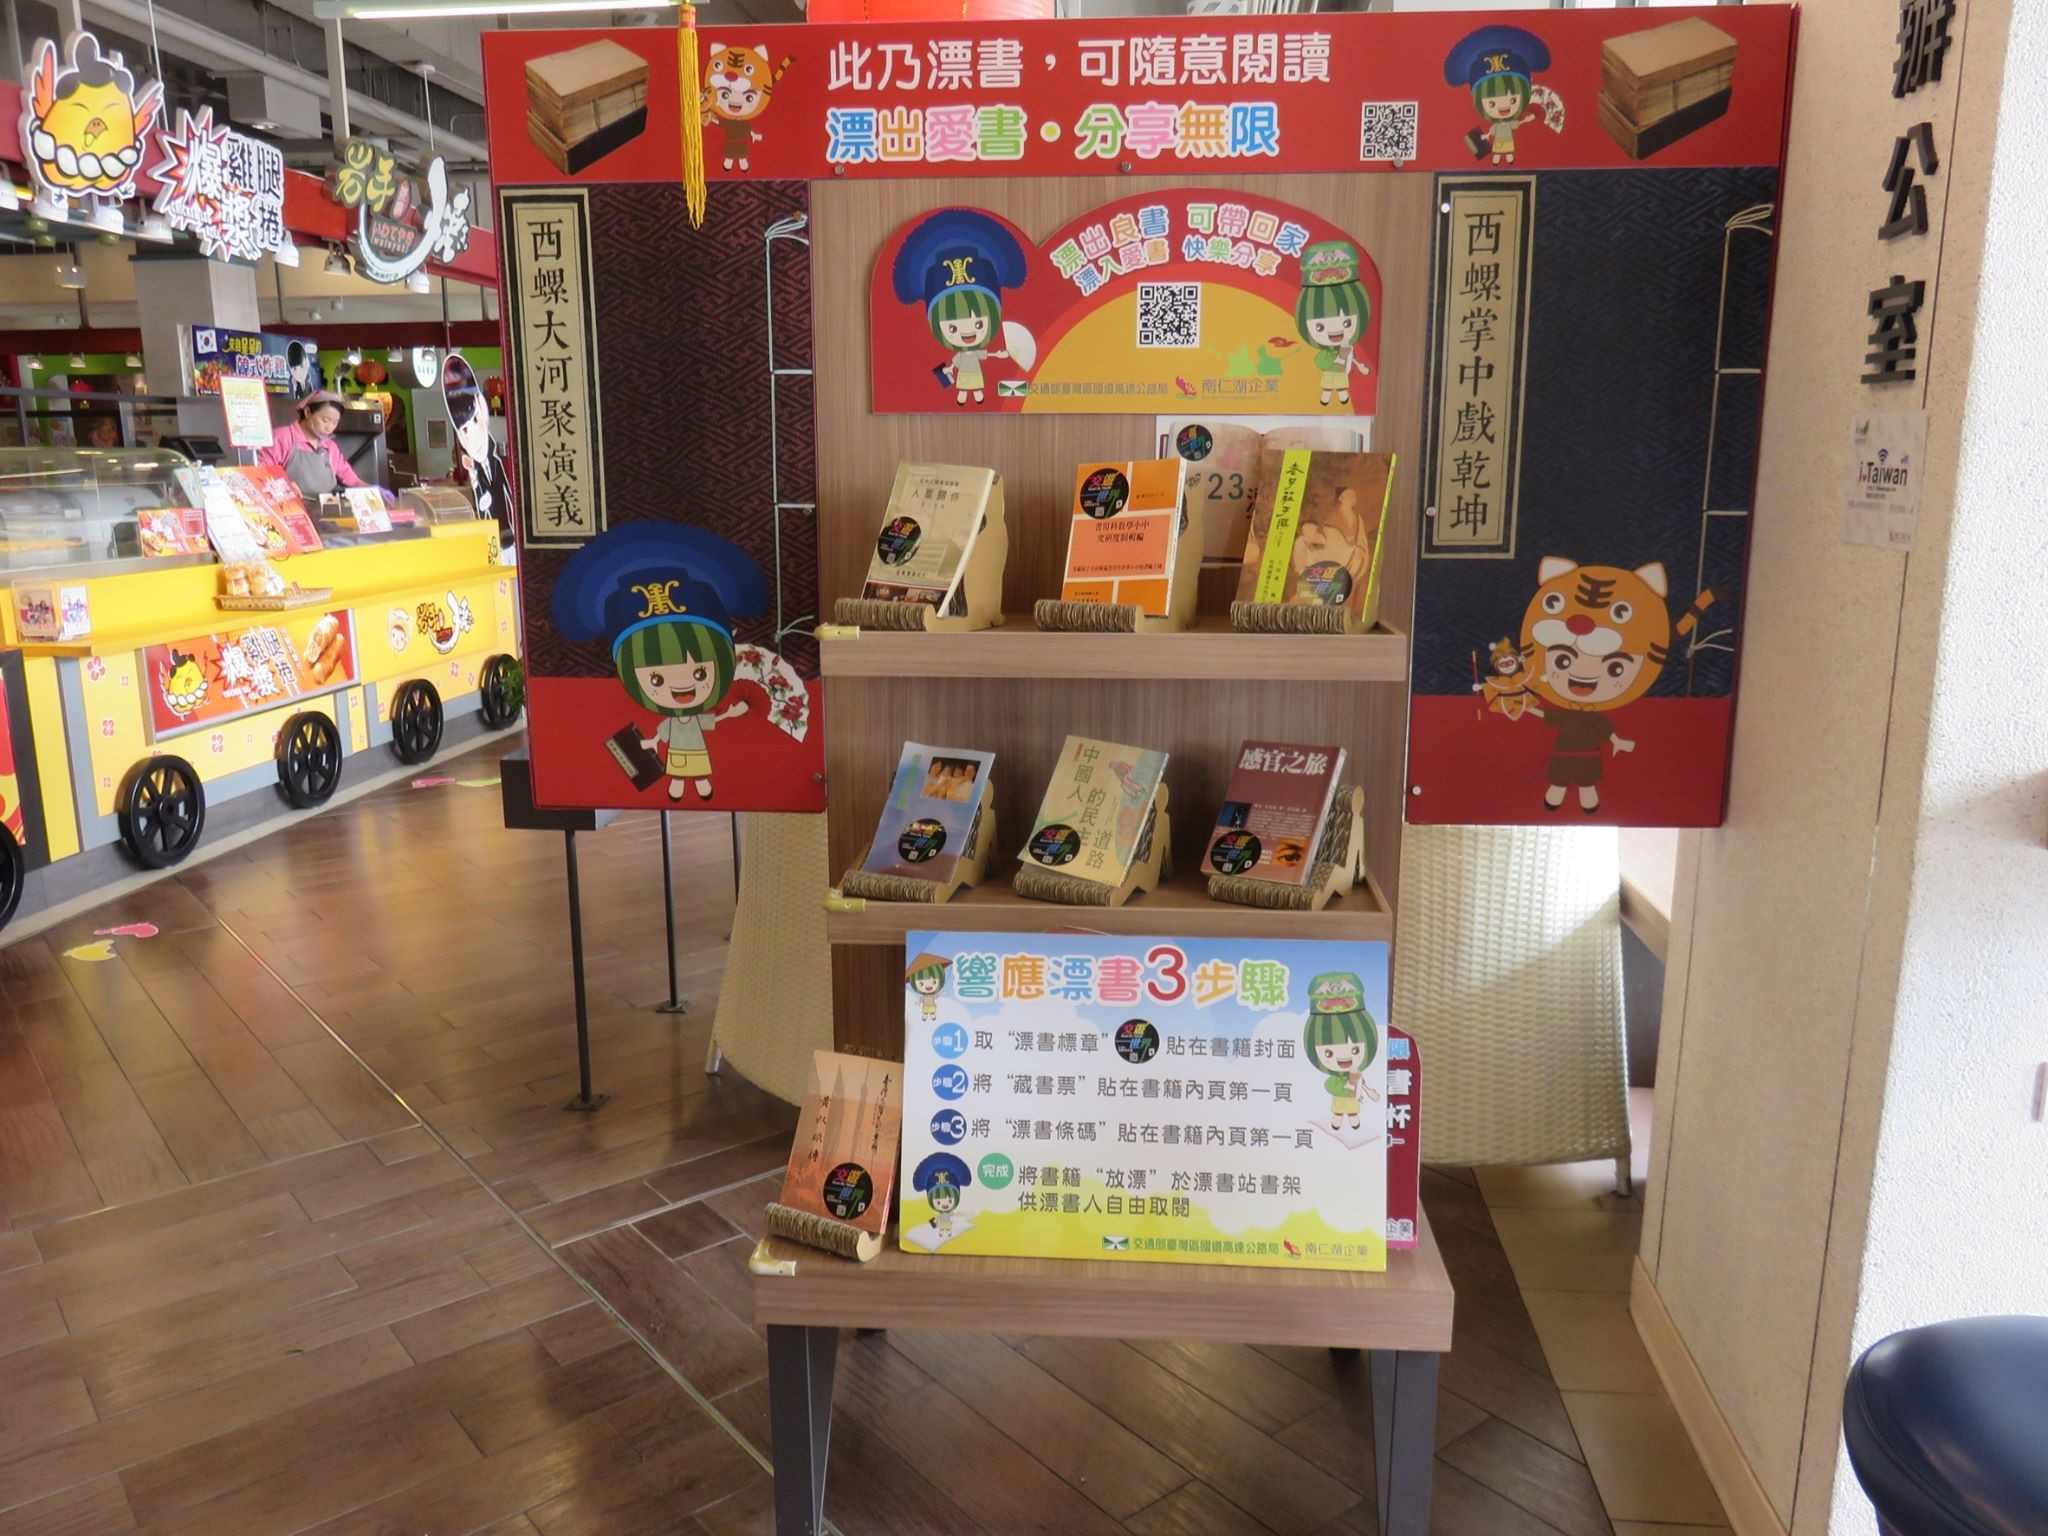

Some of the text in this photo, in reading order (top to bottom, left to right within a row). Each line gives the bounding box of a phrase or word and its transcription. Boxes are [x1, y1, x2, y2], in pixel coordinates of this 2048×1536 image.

[1051, 203, 1309, 279] 漂出良書 可帶回家
[1073, 234, 1281, 297] 漂入愛書 快樂分享
[526, 218, 584, 528] 西螺大河聚演義
[1202, 378, 1280, 394] 南仁湖企業
[1449, 209, 1506, 538] 西螺掌中戲乾坤
[1207, 472, 1244, 500] 23
[1067, 745, 1100, 803] 中國人
[1239, 747, 1329, 776] 感官之旅
[1085, 829, 1113, 870] 道路
[953, 944, 1290, 1012] 響應漂書3步驟
[1166, 1035, 1296, 1059] 貼在書籍封面
[982, 1163, 1009, 1178] 完成
[1019, 1165, 1081, 1188] 將書籍
[1171, 1170, 1302, 1196] 於漂書站書架
[1017, 1190, 1191, 1218] 供漂書人自由取閱
[1305, 1242, 1369, 1258] 南仁湖企業
